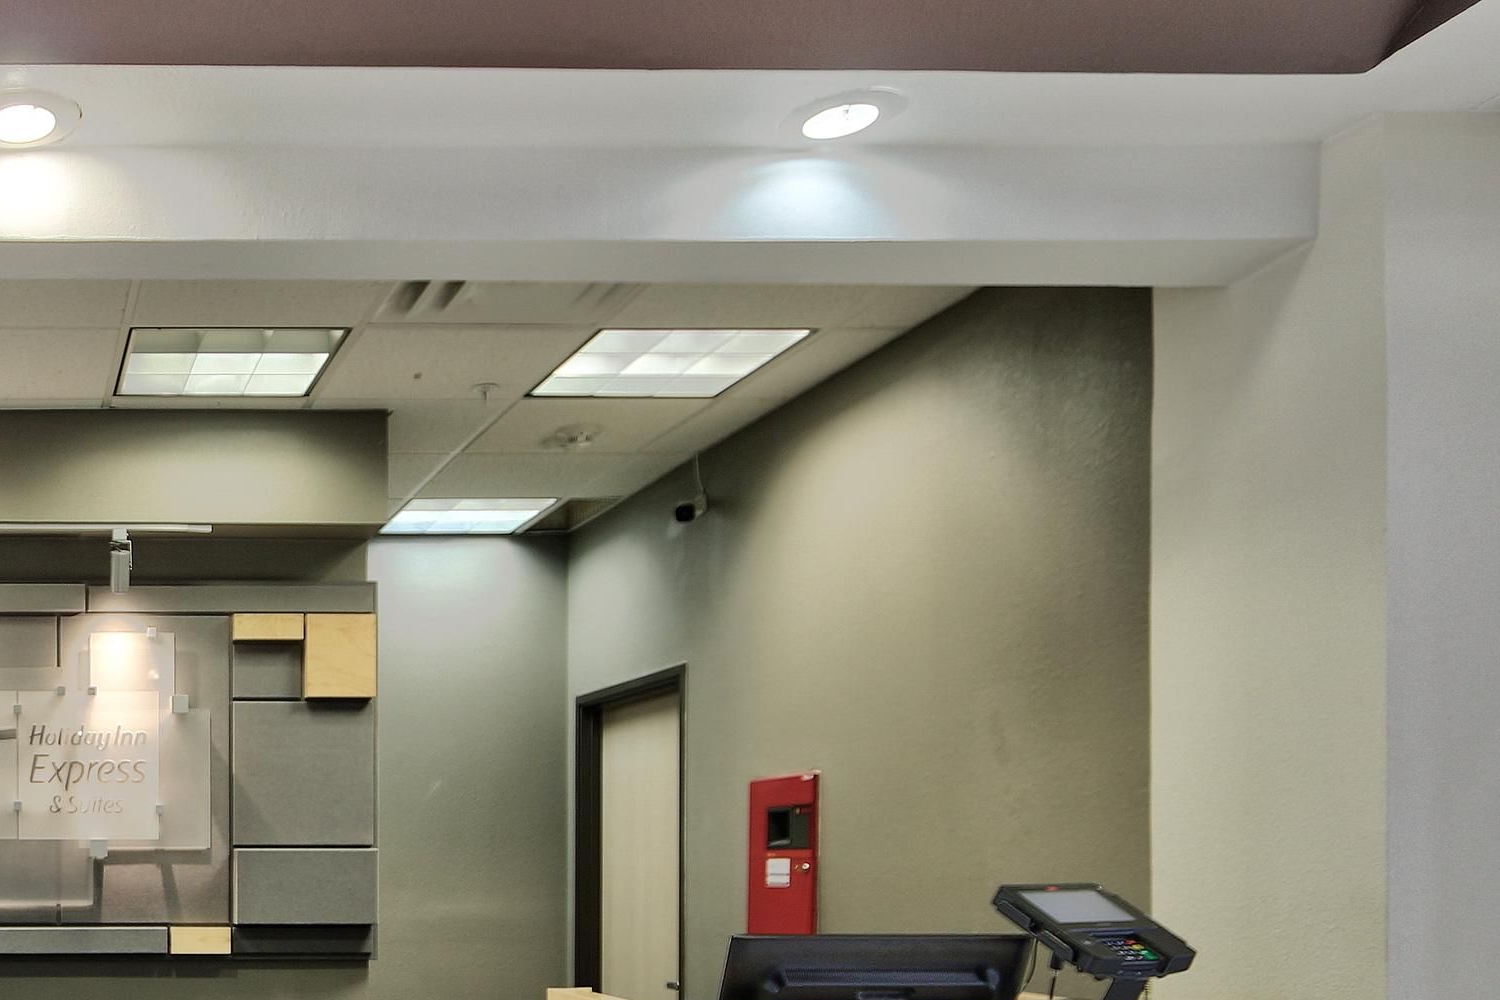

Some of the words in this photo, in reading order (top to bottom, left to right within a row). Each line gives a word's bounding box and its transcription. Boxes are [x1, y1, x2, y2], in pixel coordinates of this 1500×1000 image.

[29, 725, 110, 750] Holiday
[114, 725, 147, 746] Inn
[29, 753, 147, 791] Express
[49, 795, 62, 814] &
[67, 796, 124, 814] Suites
